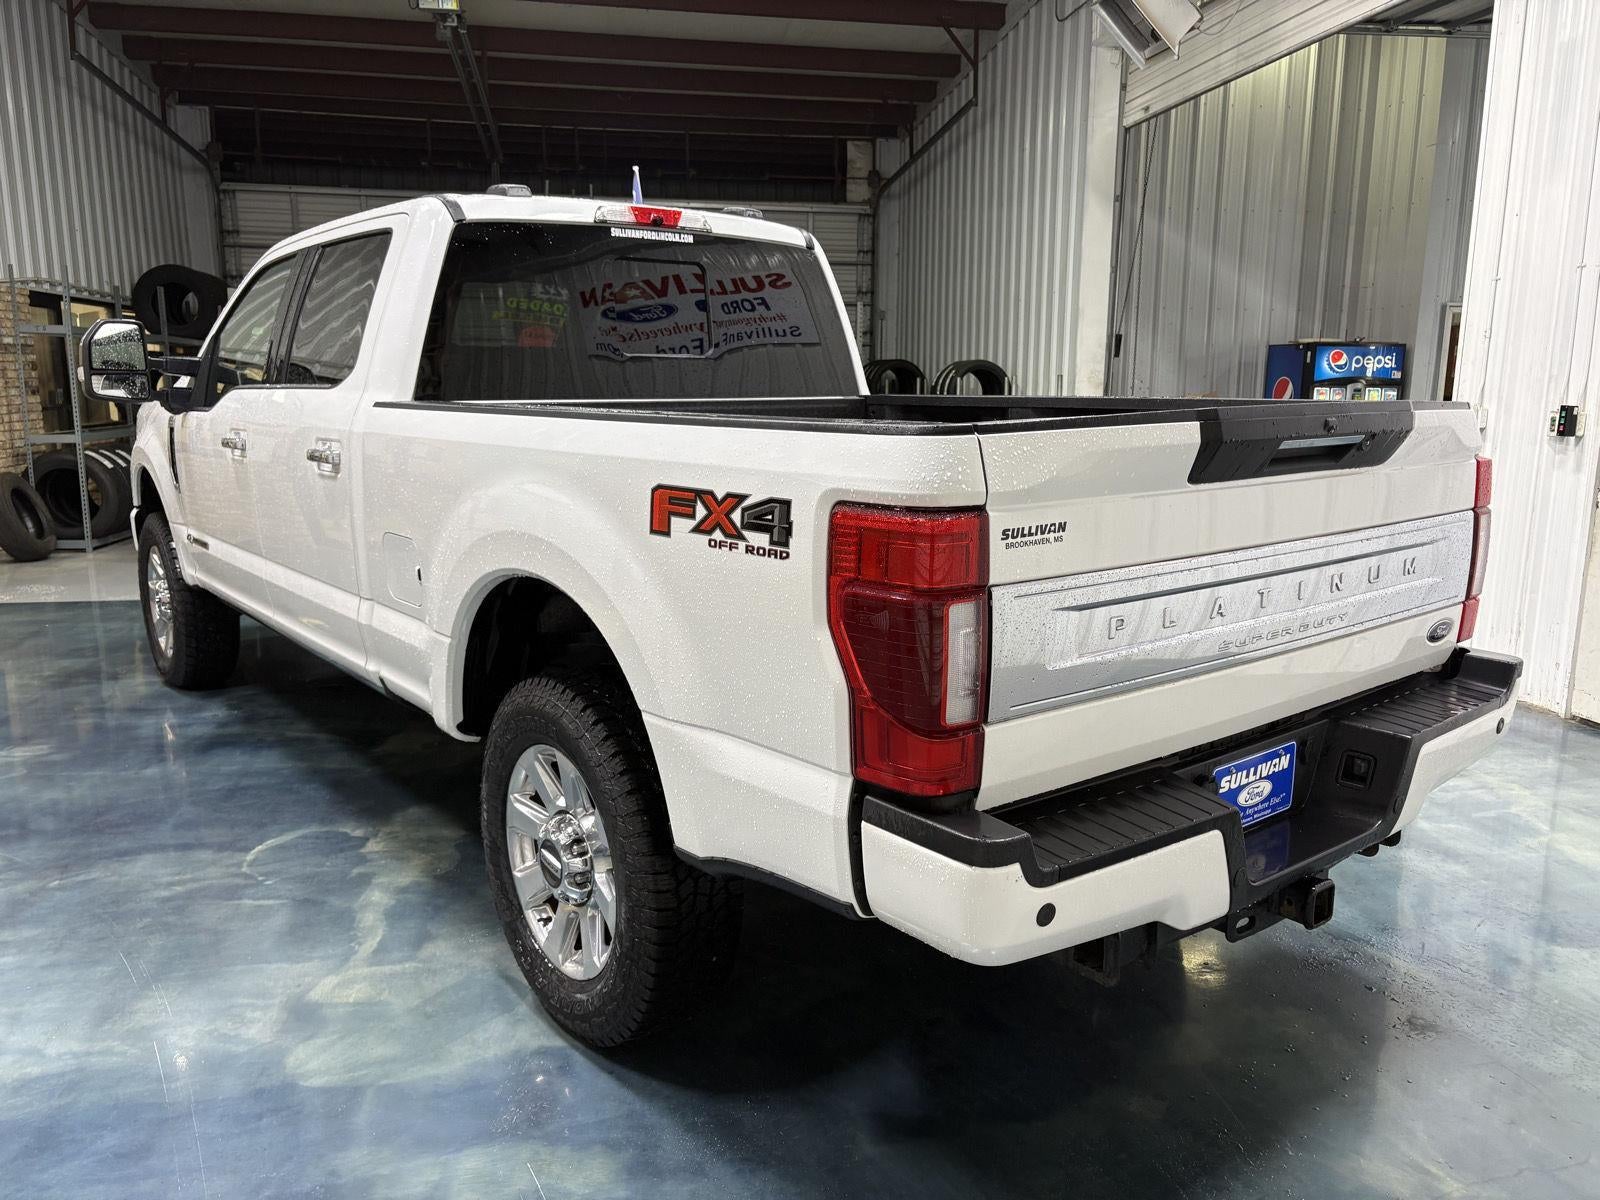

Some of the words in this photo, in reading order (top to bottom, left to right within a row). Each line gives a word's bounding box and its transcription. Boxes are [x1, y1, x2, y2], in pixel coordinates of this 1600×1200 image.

[610, 227, 694, 243] SULLIVANFORDLINCOLN.COM
[1351, 353, 1397, 371] pepsi
[649, 483, 793, 549] FX4
[1000, 521, 1067, 541] SULLIVAN
[707, 538, 740, 552] OFF
[744, 543, 791, 561] ROAD
[1005, 537, 1053, 550] BROOKHAVEN,
[1053, 535, 1064, 543] MS
[1107, 556, 1419, 640] PLATINUM
[1218, 754, 1291, 793] SULLIVAN
[1244, 785, 1266, 803] Ford
